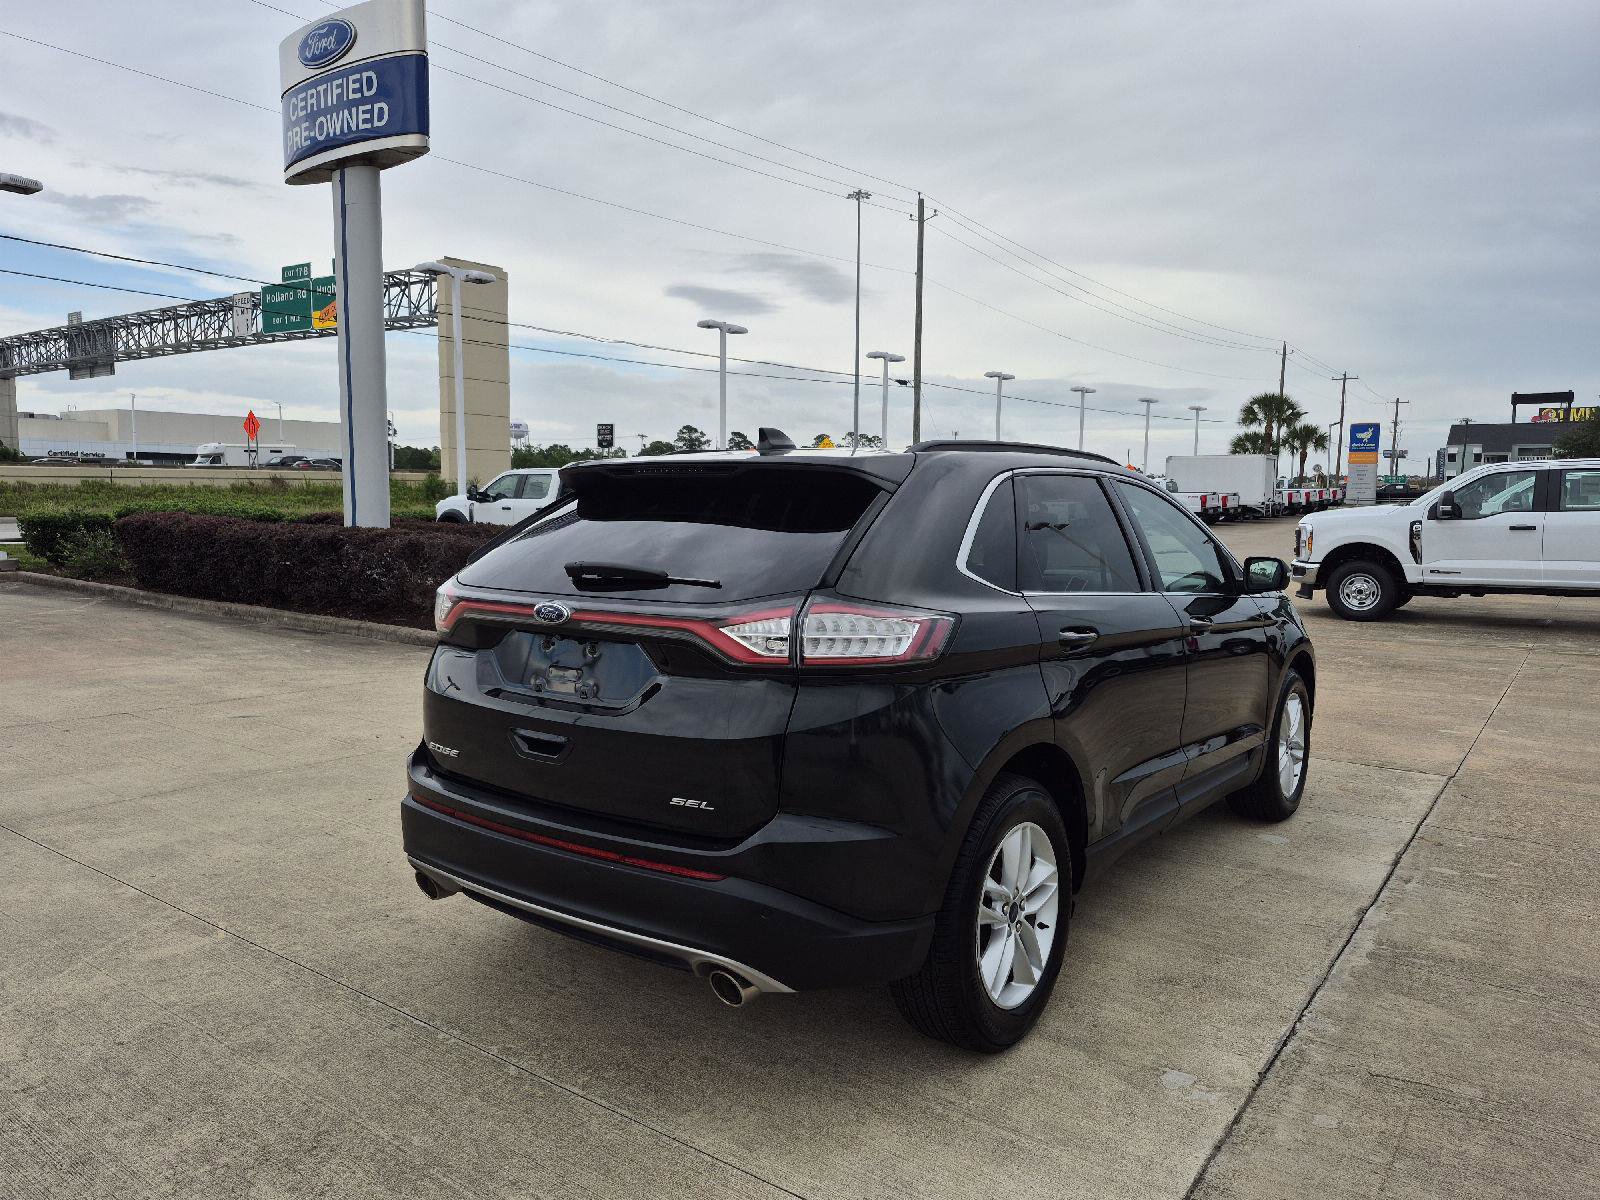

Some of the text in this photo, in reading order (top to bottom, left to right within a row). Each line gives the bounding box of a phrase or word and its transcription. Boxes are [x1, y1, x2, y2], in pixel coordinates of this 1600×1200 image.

[305, 26, 337, 59] Ford
[290, 71, 378, 121] CERTIFIED
[287, 102, 389, 155] PRE-OWNED
[235, 297, 251, 306] SPEED
[266, 288, 307, 303] Holland Rd
[47, 449, 106, 458] Certified Service
[429, 741, 460, 758] EDGE
[669, 797, 715, 810] SEL
